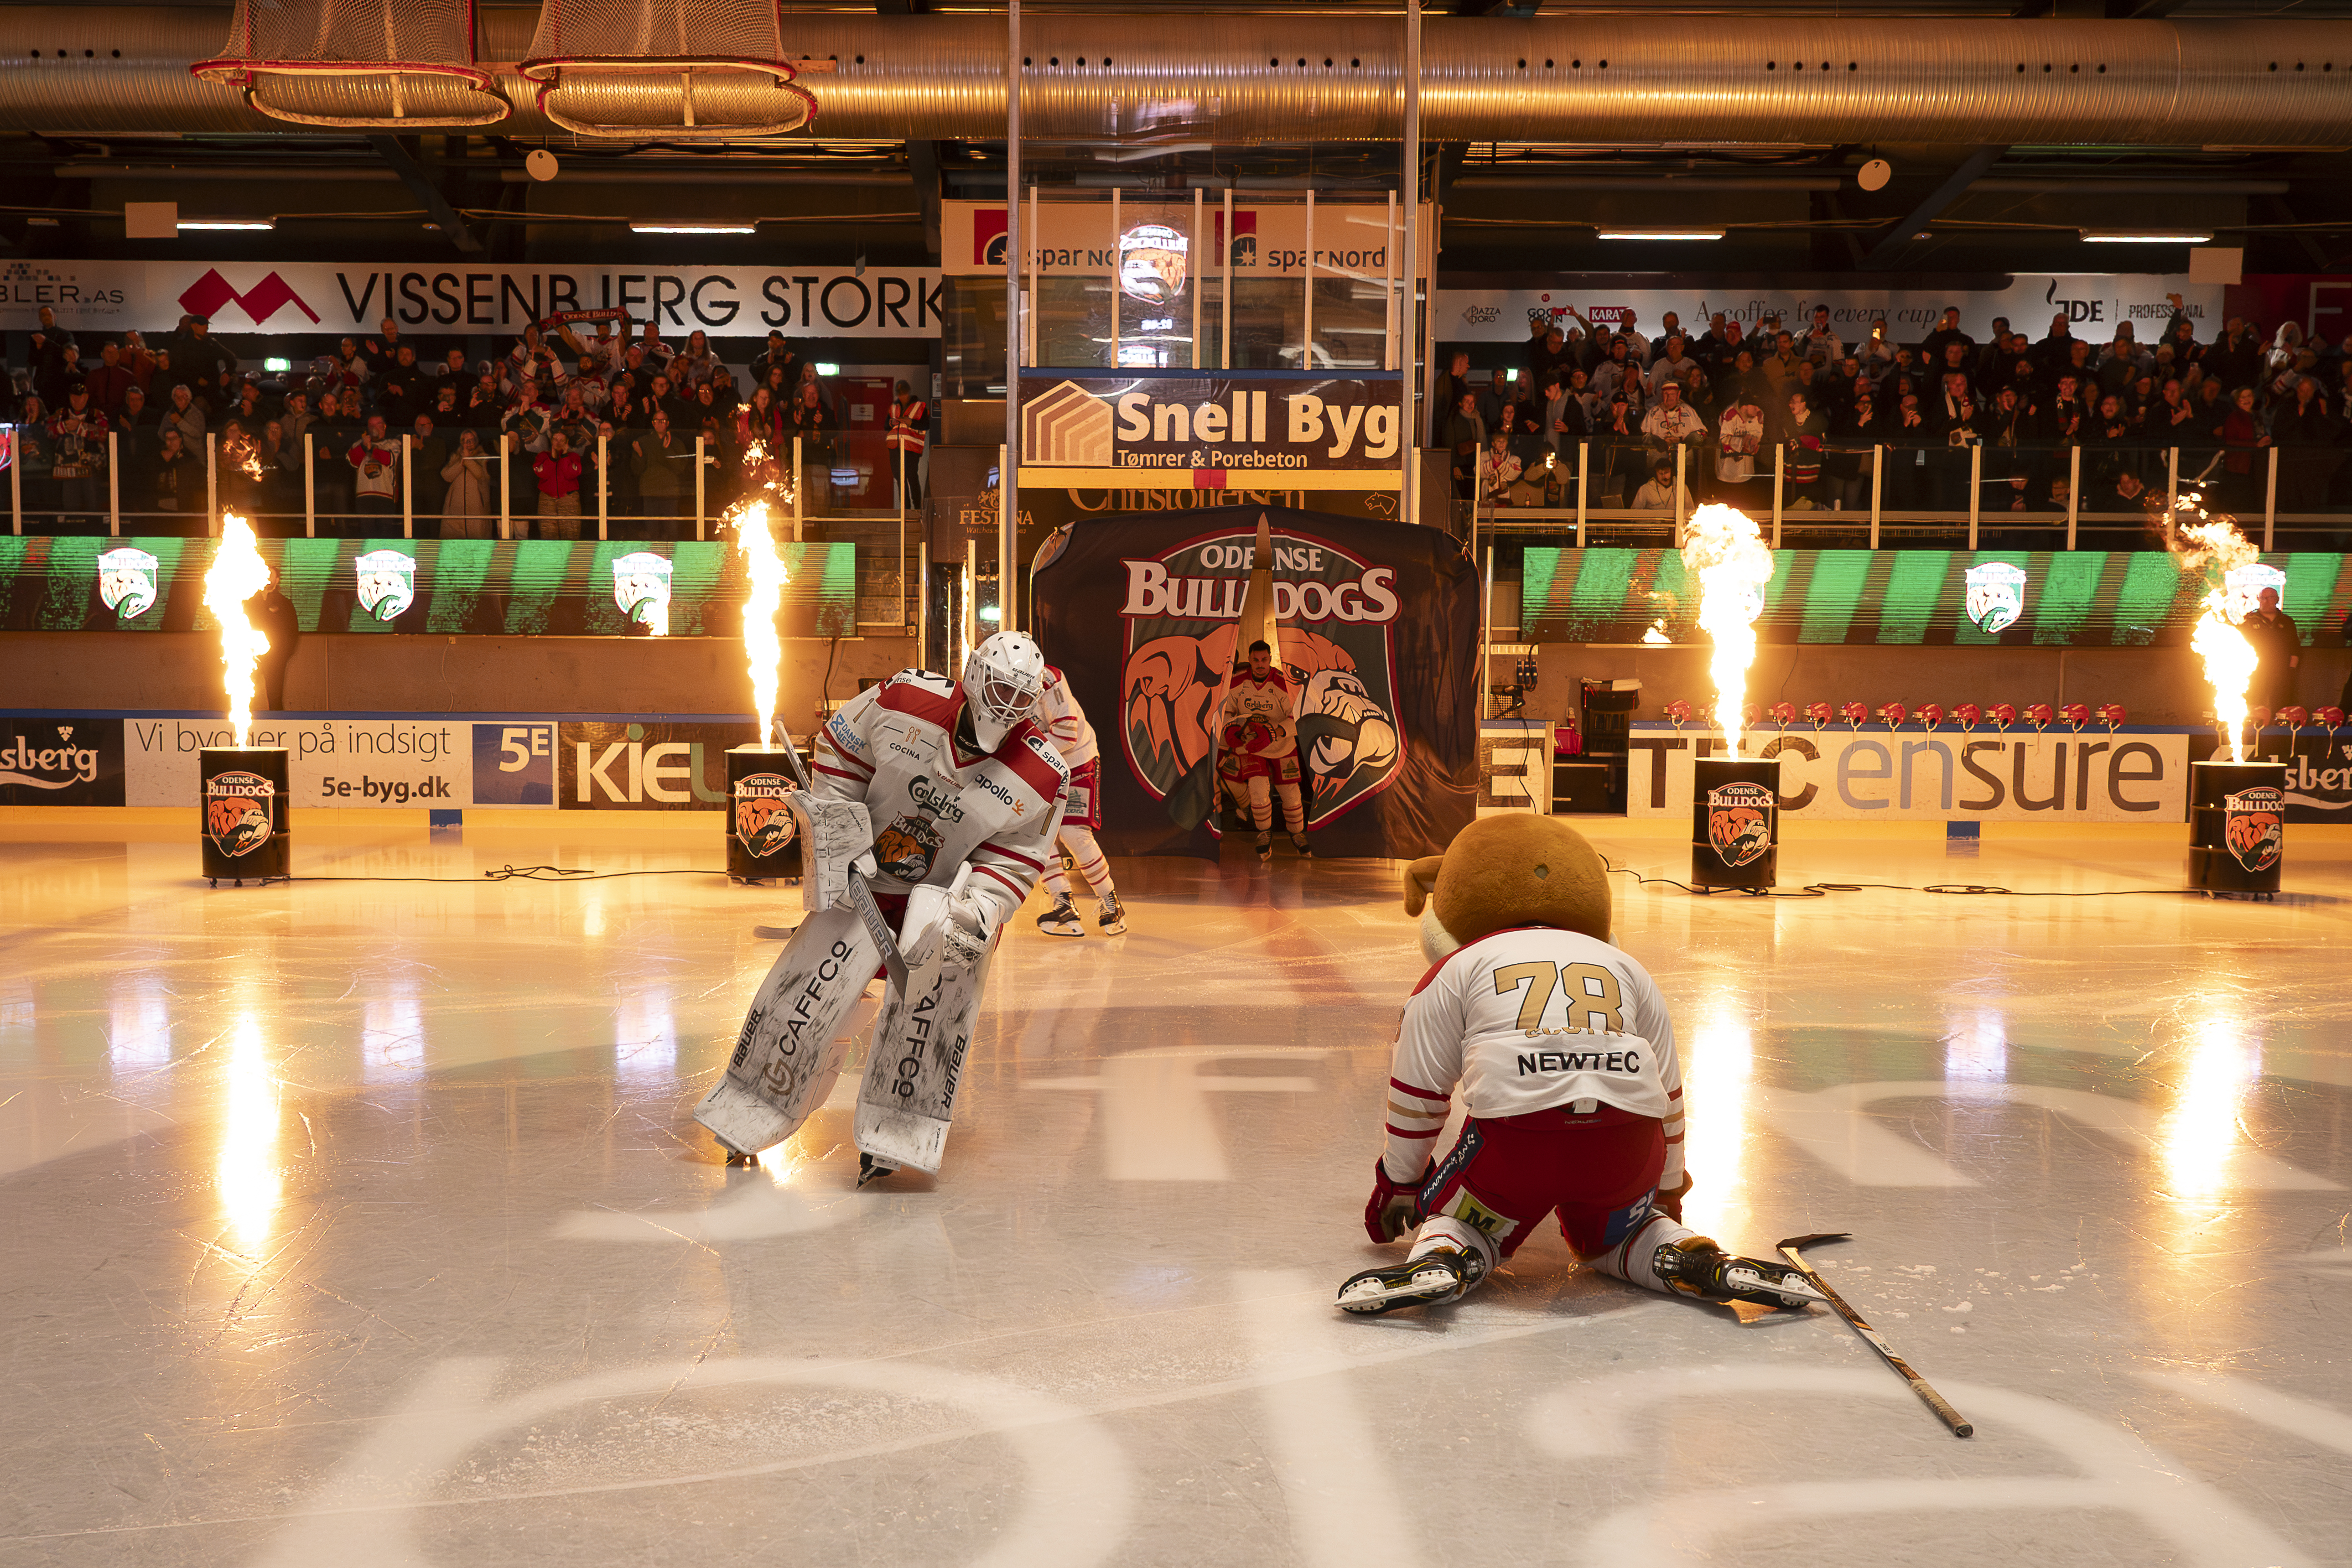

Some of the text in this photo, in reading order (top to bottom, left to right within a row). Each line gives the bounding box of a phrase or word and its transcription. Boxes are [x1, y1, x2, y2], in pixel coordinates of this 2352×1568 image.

[1268, 250, 1324, 272] spar
[1471, 305, 1500, 315] PIAZZA
[1696, 300, 1713, 322] A
[1723, 300, 1788, 322] coffee
[1834, 308, 1891, 324] every
[1898, 308, 1936, 329] cup
[1117, 391, 1400, 459] Snell Byg
[1117, 449, 1308, 468] Tømrer & Porebeton
[959, 510, 1034, 525] FESTNA
[1200, 544, 1325, 572] ODENSE
[1122, 559, 1398, 622] BULLDOGS
[1012, 667, 1036, 680] BAUER
[136, 723, 163, 752] Vi
[299, 723, 335, 761] på
[349, 723, 451, 762] indsigt
[836, 731, 860, 755] METAL
[842, 723, 866, 749] DANSK
[889, 742, 921, 761] COCINA
[1042, 751, 1066, 771] spar
[207, 781, 273, 797] BULLDOGS
[974, 773, 1013, 806] apollo
[1836, 740, 2164, 812] ensure
[322, 777, 451, 804] 5e-byg.dk
[1709, 791, 1773, 807] BULLDOGS
[850, 880, 892, 961] BAUER
[778, 939, 853, 1057] CAFFCO
[1493, 960, 1625, 1035] 78
[733, 1009, 763, 1069] BAUER
[940, 1034, 969, 1109] BAUER
[1517, 1051, 1640, 1077] NEWTEC
